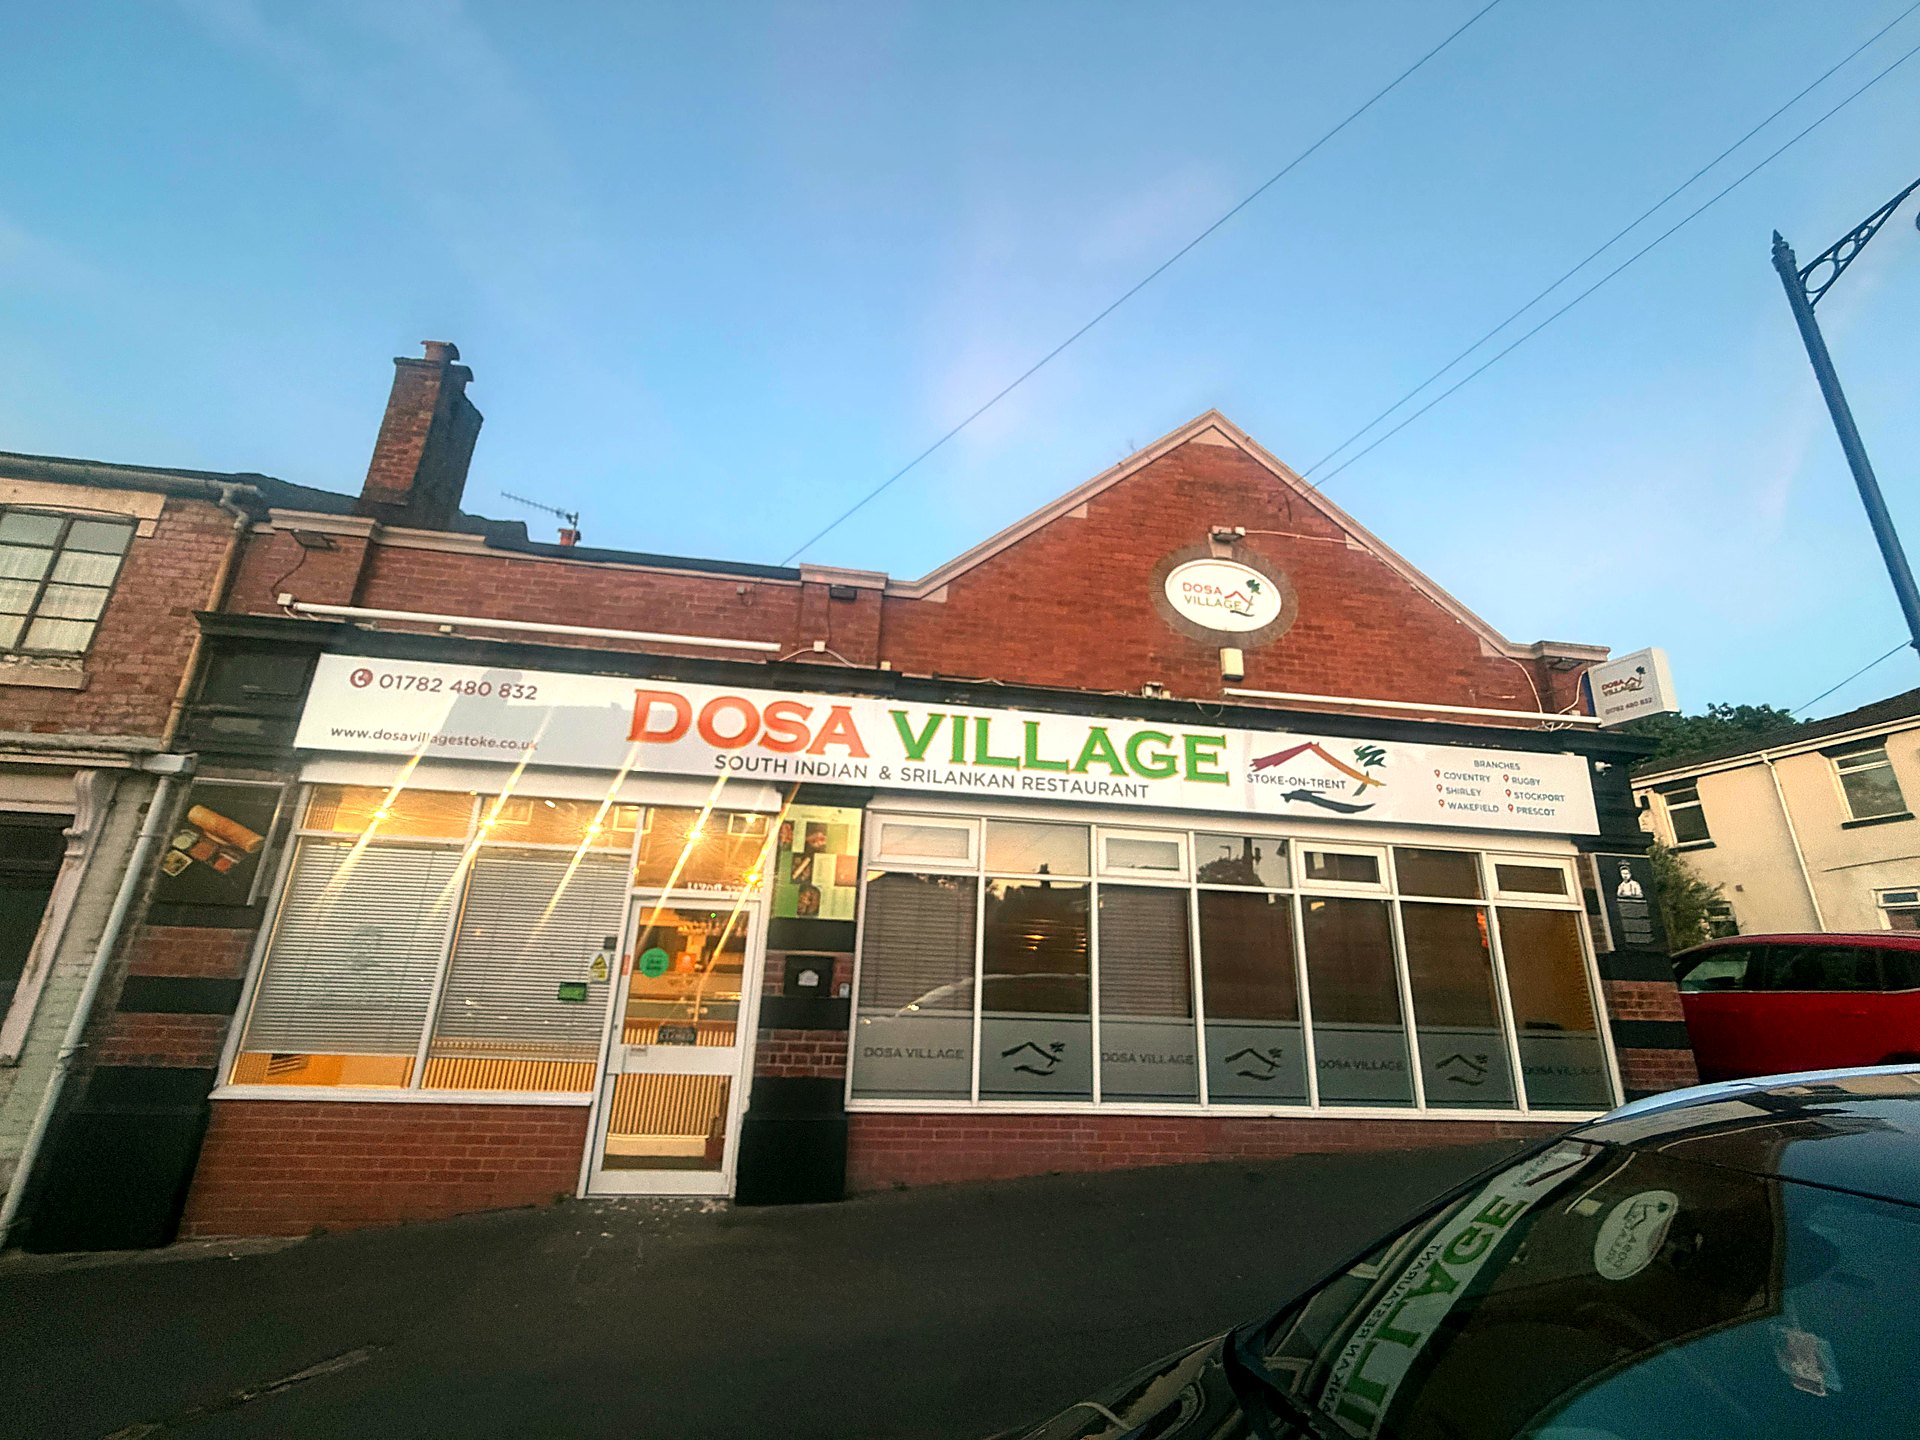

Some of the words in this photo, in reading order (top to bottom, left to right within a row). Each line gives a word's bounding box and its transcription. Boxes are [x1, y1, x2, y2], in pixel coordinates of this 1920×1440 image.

[1182, 582, 1222, 595] DOSA
[1184, 595, 1242, 611] VILLAGE
[379, 673, 443, 693] 01782
[449, 679, 493, 697] 480
[497, 683, 538, 700] 832
[626, 688, 870, 758] DOSA
[888, 709, 1230, 786] VILLAGE
[1473, 760, 1521, 771] BRANCHES
[714, 754, 787, 774] SOUTH
[795, 760, 868, 779] INDIAN
[878, 765, 891, 780] &
[901, 767, 1016, 790] SRILANKAN
[1022, 776, 1149, 799] RESTAURANT
[1247, 773, 1347, 790] STOKE-ON-TRENT
[1443, 772, 1491, 783] COVENTRY
[1511, 776, 1542, 787] RUGBY
[1445, 787, 1482, 797] SHIRLEY
[1513, 791, 1566, 803] STOCKPORT
[1447, 802, 1500, 813] WAKEFIELD
[1516, 805, 1556, 817] PRESCOT
[864, 1048, 903, 1058] DOSA
[906, 1050, 965, 1060] VILLAGE
[1102, 1052, 1137, 1063] DOSA
[1140, 1054, 1194, 1065] VILLAGE
